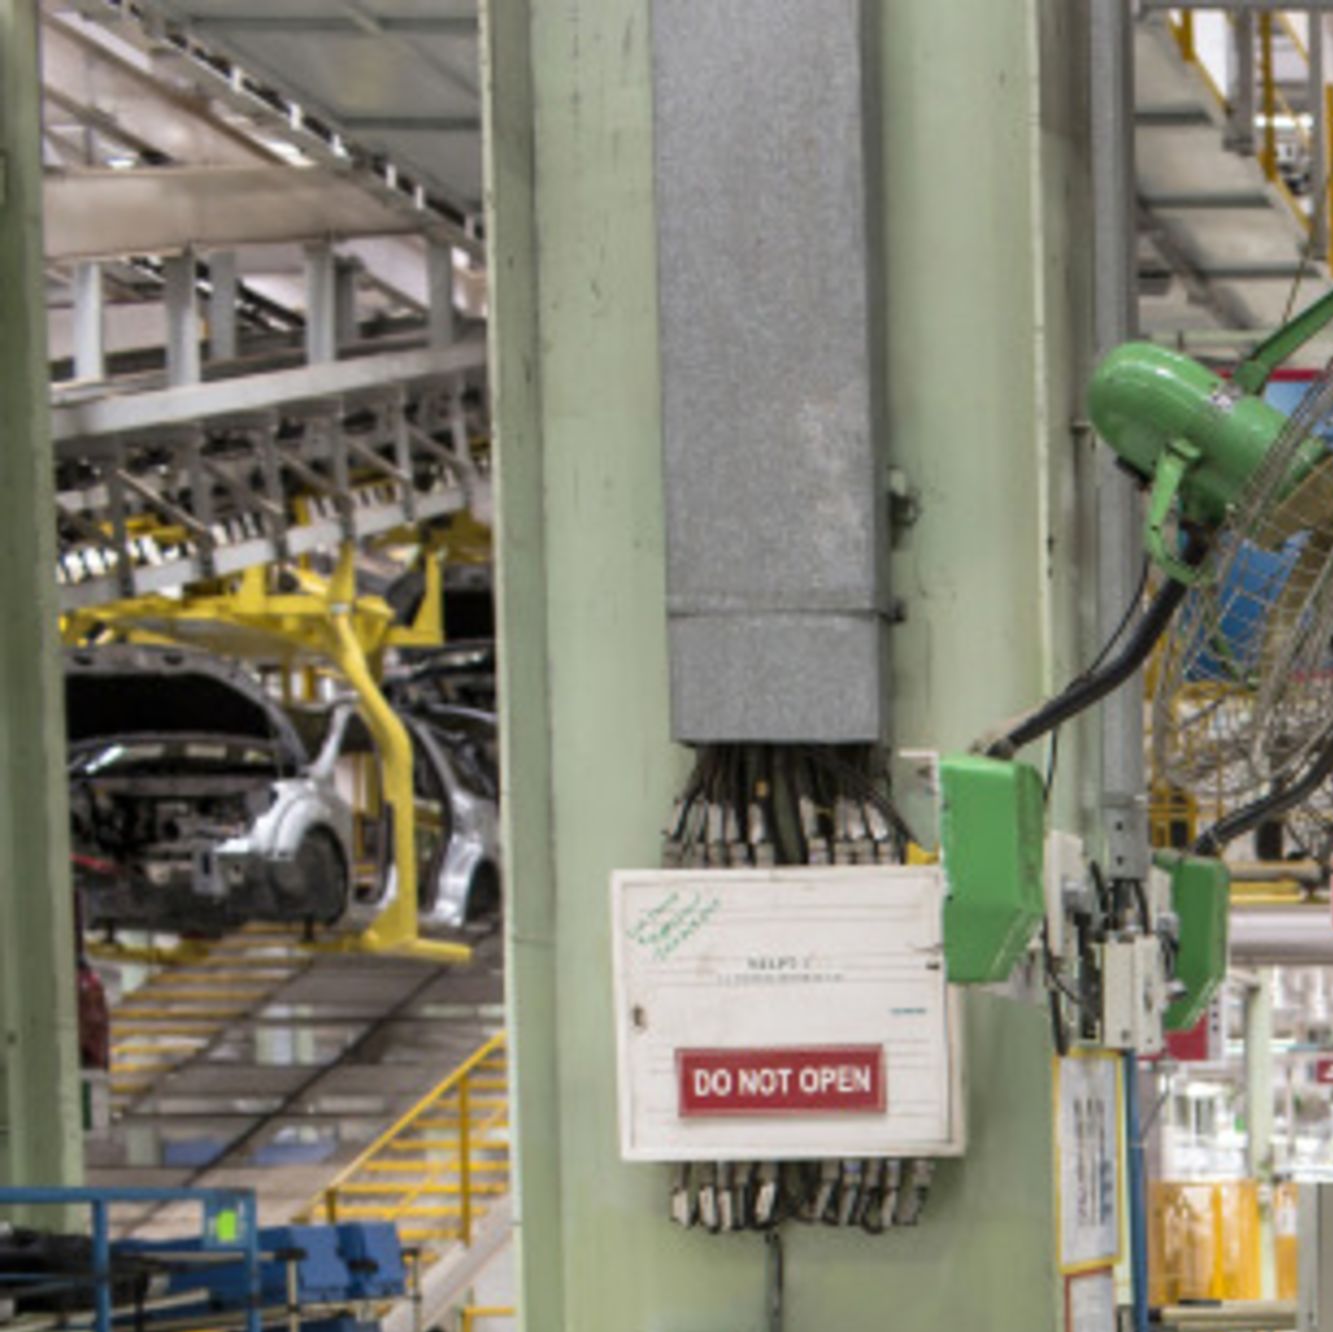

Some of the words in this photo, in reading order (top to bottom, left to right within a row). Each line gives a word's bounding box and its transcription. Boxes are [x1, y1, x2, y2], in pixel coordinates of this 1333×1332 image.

[693, 1067, 732, 1097] DO
[738, 1066, 793, 1096] NOT
[799, 1063, 871, 1093] OPEN
